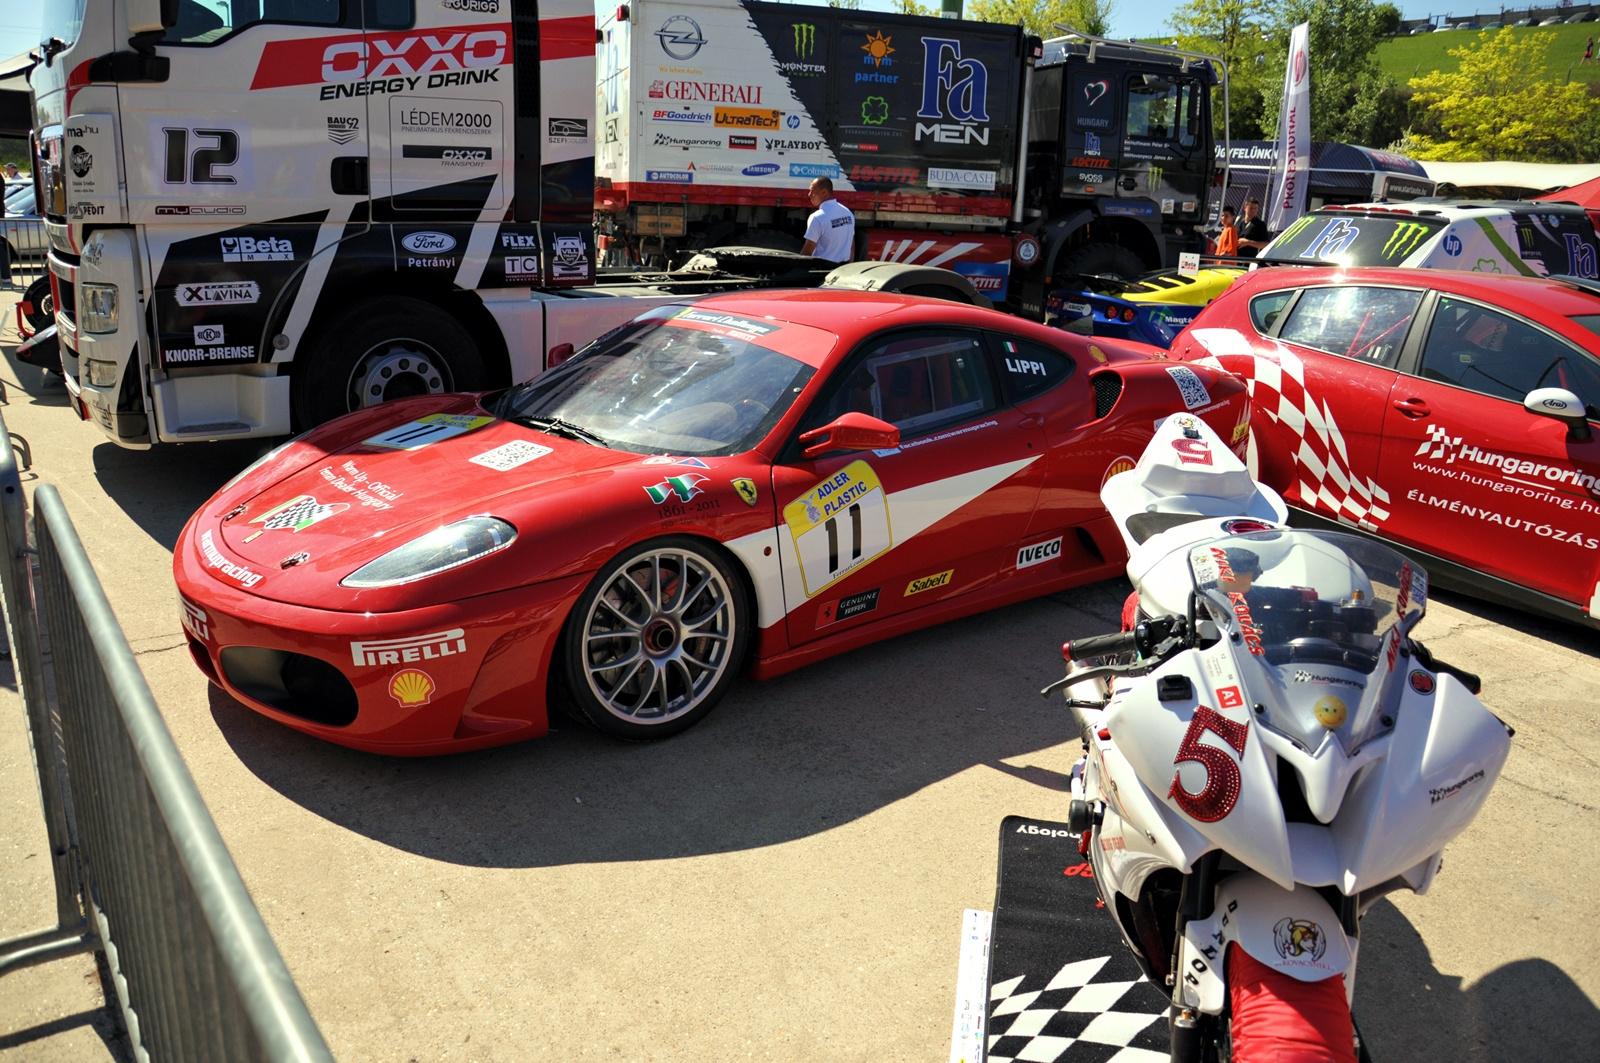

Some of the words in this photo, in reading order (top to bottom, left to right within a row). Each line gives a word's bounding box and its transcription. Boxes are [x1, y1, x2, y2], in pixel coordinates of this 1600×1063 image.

[321, 30, 507, 82] OXXO
[781, 61, 826, 74] MONSTER
[855, 71, 899, 84] partner
[320, 76, 422, 101] ENERGY
[427, 68, 500, 89] DRINK
[917, 36, 990, 122] Fa
[665, 80, 763, 104] GENERALI
[401, 107, 492, 128] LÉDEM2000
[653, 109, 712, 121] BFGoodrich
[787, 114, 799, 129] hp
[1077, 117, 1109, 127] HUNGARY
[401, 126, 444, 134] PNEUMATIKUS
[915, 121, 989, 146] MEN
[670, 137, 721, 147] Hungaroring
[774, 138, 822, 150] PLAYBOY
[162, 127, 240, 185] 12
[441, 160, 485, 168] TRANSPORT
[442, 149, 487, 160] OXXO
[1072, 157, 1111, 169] LOCTITE
[659, 172, 690, 181] AUTOCOLOR
[747, 165, 777, 174] SAMSUNG
[800, 165, 837, 177] Columbia
[850, 164, 921, 184] LOCTITE
[929, 169, 994, 184] BUDA-CASH
[240, 236, 294, 253] Beta
[413, 234, 445, 249] Ford
[501, 235, 536, 247] FLEX
[1300, 217, 1360, 259] Fa
[408, 256, 456, 269] Petrányi
[1562, 232, 1599, 279] Fa
[1022, 303, 1040, 312] MAN
[165, 345, 255, 363] KNORR-BREMSE
[1005, 357, 1047, 376] LIPPI
[1545, 398, 1564, 408] Arai
[384, 424, 448, 444] 11
[817, 471, 851, 500] ADLER
[1412, 461, 1600, 515] www.hungaroring.hu
[823, 480, 868, 516] PLASTIC
[657, 503, 686, 519] 1861
[695, 498, 721, 512] 2011
[1406, 489, 1600, 550] ÉLMÉNYAUTÓZÁS
[825, 502, 862, 575] 11
[201, 528, 264, 588] warmupracing
[1018, 539, 1061, 566] IVECO
[833, 557, 866, 579] Ferrari.com
[1209, 546, 1236, 583] NIKI
[909, 572, 949, 594] Sabelt
[840, 591, 878, 609] GENUINE
[350, 628, 467, 667] PIRELLI
[1312, 674, 1365, 690] Hungaroring
[1220, 688, 1238, 708] A1
[1167, 704, 1250, 823] 5
[1184, 899, 1239, 987] DUNLOP
